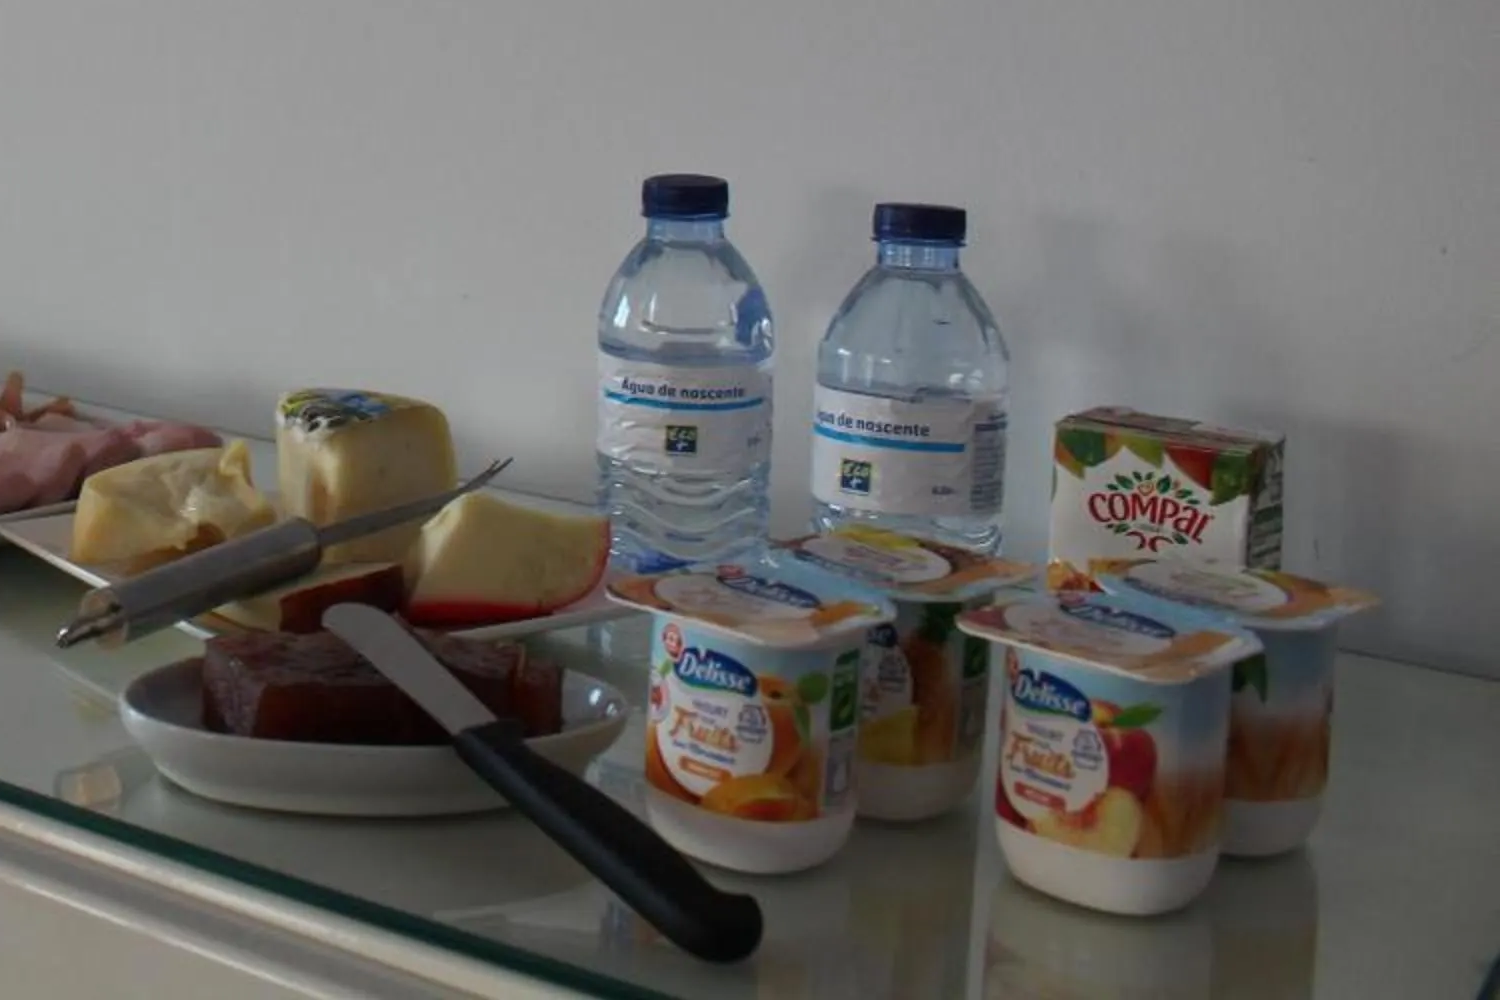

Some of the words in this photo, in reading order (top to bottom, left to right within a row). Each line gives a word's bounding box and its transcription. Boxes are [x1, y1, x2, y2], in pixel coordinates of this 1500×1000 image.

[657, 383, 677, 396] de
[679, 385, 746, 399] nascente
[837, 411, 853, 428] de
[855, 417, 930, 438] nascente
